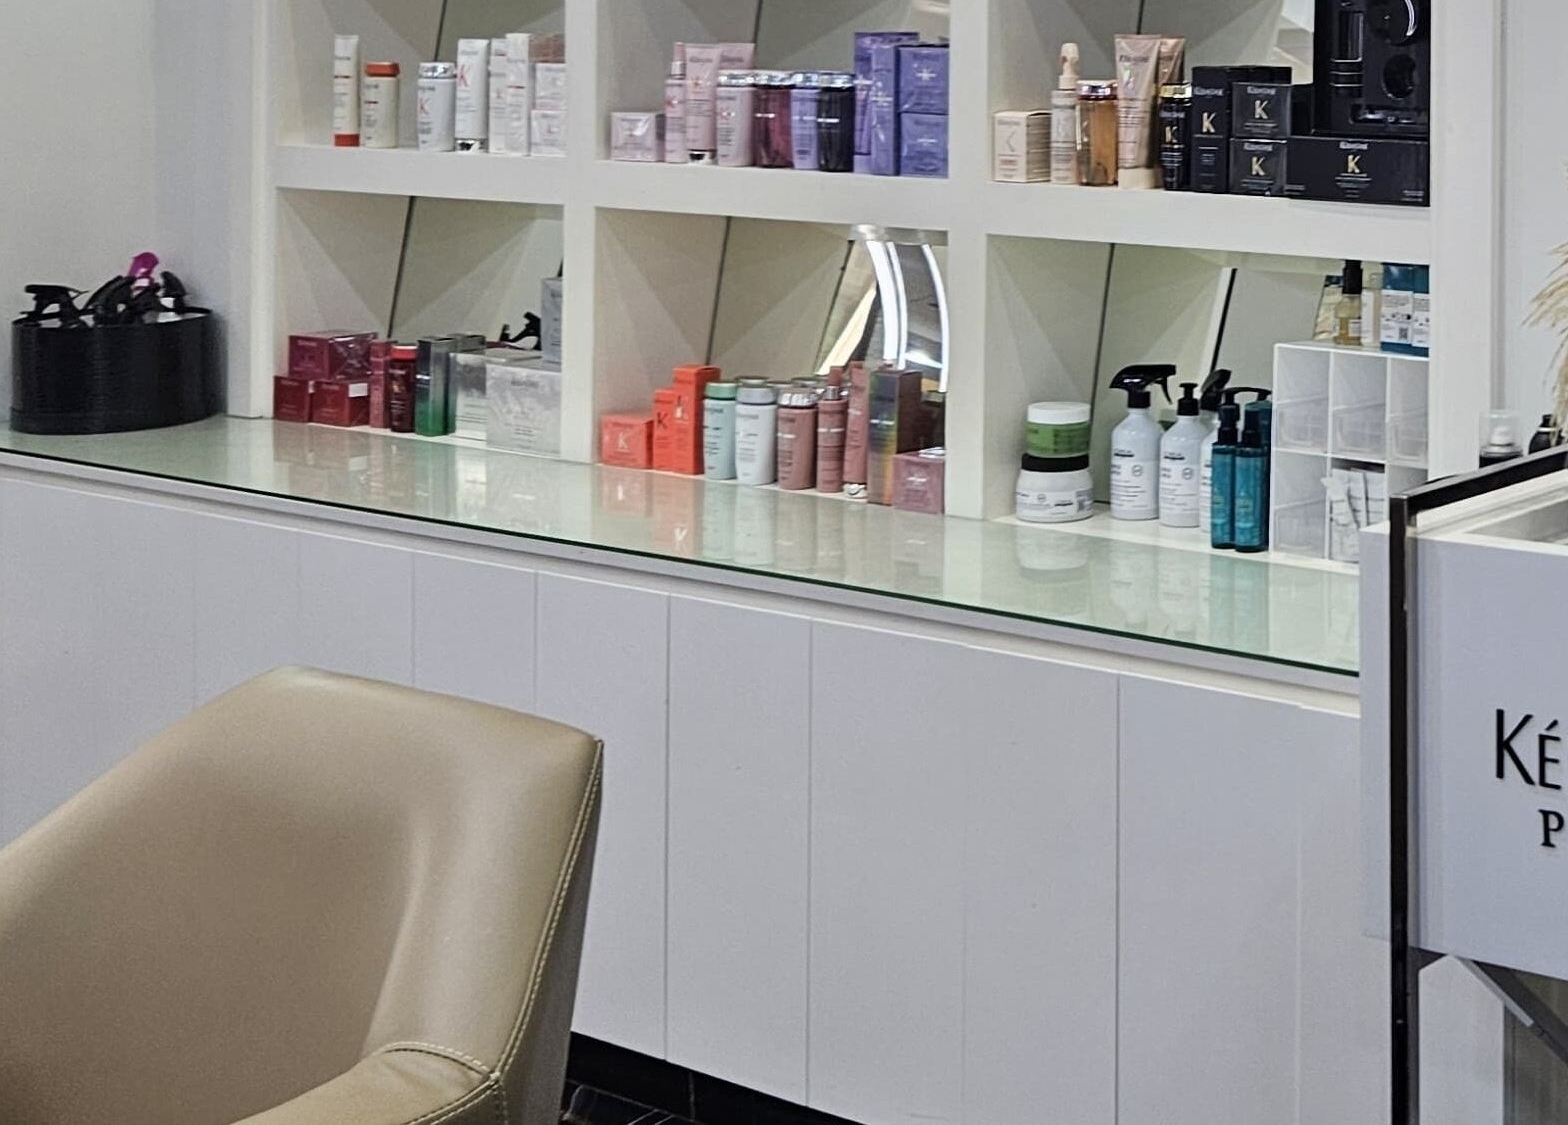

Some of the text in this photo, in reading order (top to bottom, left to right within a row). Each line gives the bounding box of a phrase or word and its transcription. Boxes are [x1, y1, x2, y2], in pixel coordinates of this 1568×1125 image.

[1254, 100, 1268, 119] K
[1202, 112, 1216, 133] K
[1165, 126, 1179, 143] K
[1252, 156, 1266, 176] K
[1347, 154, 1360, 173] K
[657, 412, 668, 429] K
